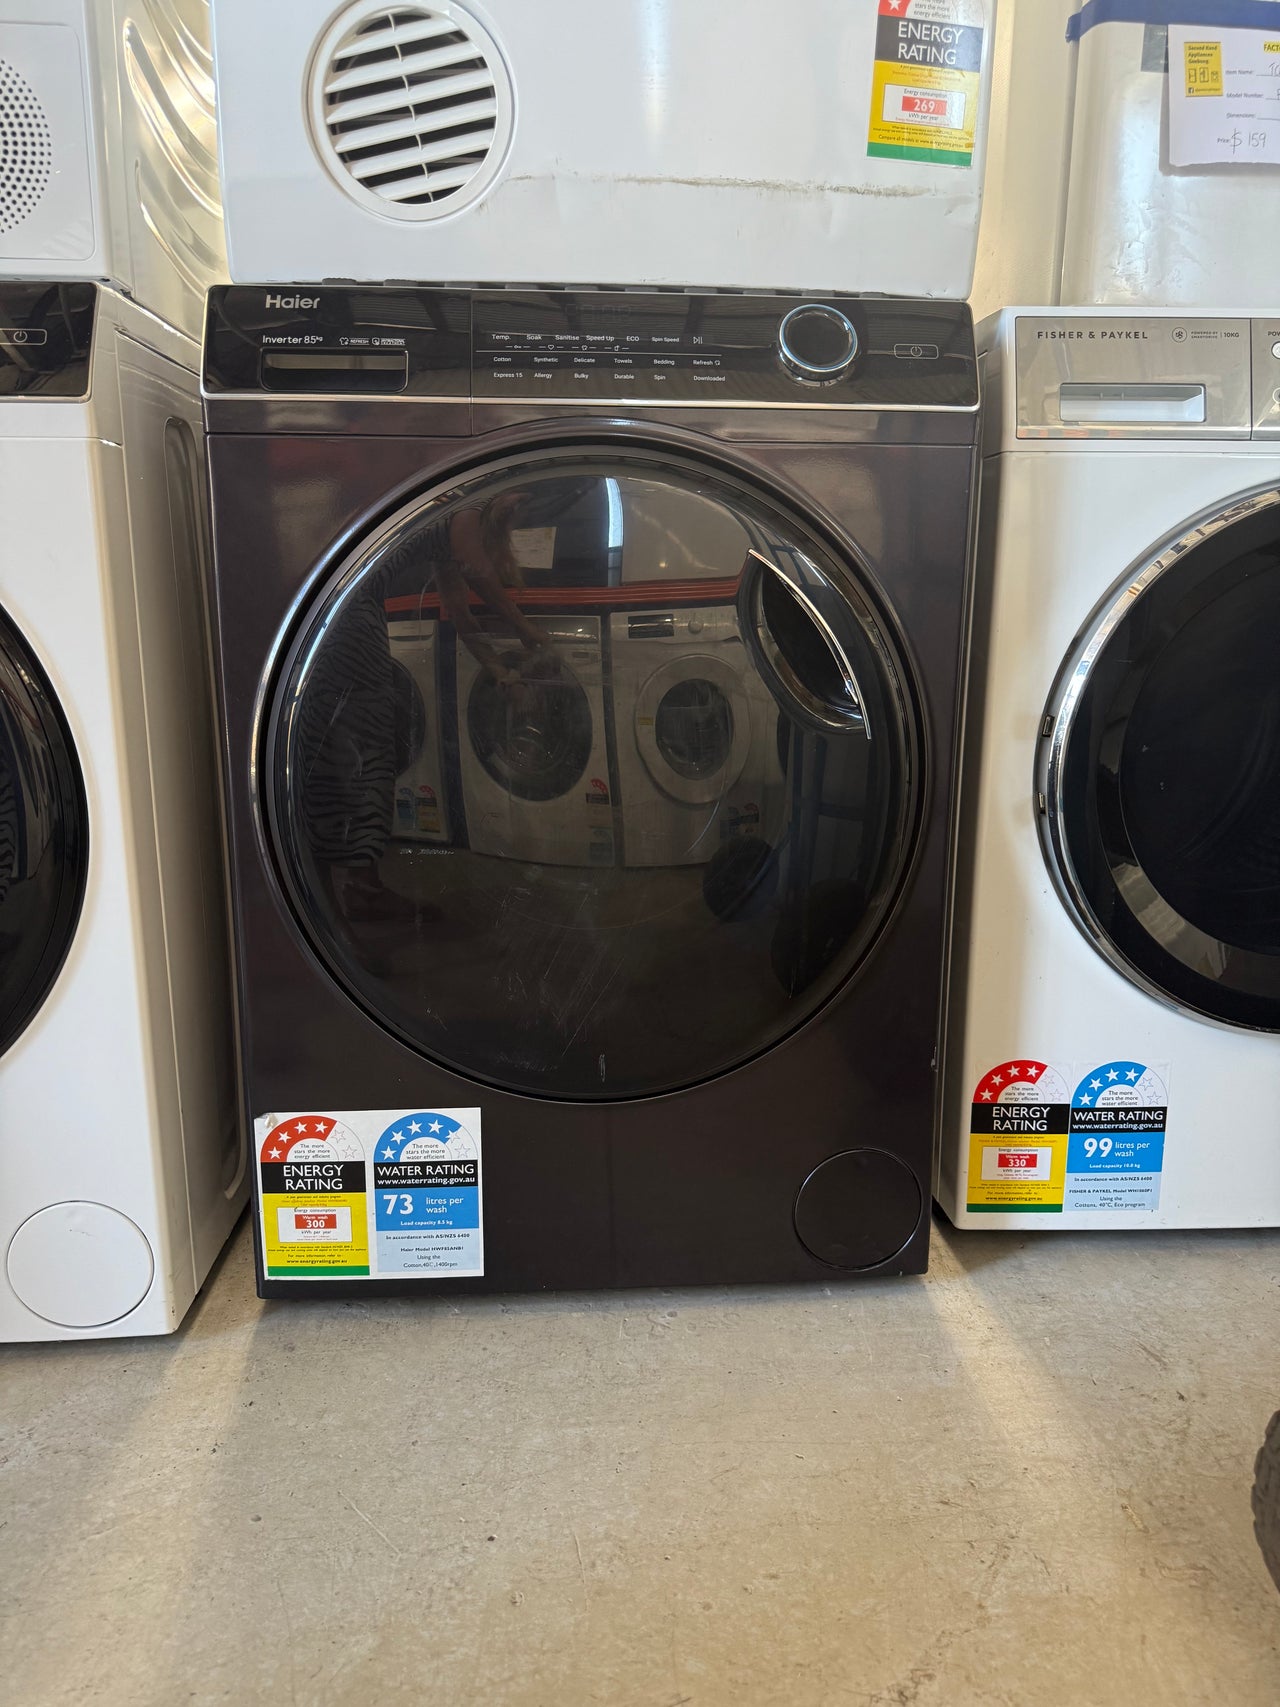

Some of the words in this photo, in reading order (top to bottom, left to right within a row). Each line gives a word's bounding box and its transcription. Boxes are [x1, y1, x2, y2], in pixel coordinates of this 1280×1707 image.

[898, 21, 964, 45] ENERGY
[898, 43, 957, 65] RATING
[904, 88, 919, 97] Energy
[914, 98, 936, 113] 269
[1231, 128, 1242, 155] $
[1248, 132, 1267, 148] 159
[265, 294, 321, 309] Haier
[262, 335, 302, 344] Inverter
[1037, 331, 1084, 339] FISHER
[1088, 331, 1096, 339] &
[1101, 331, 1148, 339] PAYKEL
[992, 1107, 1051, 1118] ENERGY
[1073, 1111, 1115, 1121] WATER
[1118, 1110, 1164, 1121] RATING
[993, 1120, 1048, 1131] RATING
[1072, 1122, 1163, 1131] www.waterrating.gov.au
[1083, 1137, 1113, 1158] 99
[1115, 1141, 1134, 1149] litres
[1136, 1142, 1150, 1150] per
[1008, 1159, 1027, 1167] 330
[283, 1164, 344, 1177] ENERGY
[377, 1165, 422, 1176] WATER
[426, 1164, 475, 1175] RATING
[285, 1178, 343, 1191] RATING
[377, 1176, 476, 1185] www.waterrating.gov.au
[383, 1194, 414, 1215] 73
[425, 1197, 447, 1205] litres
[449, 1197, 465, 1206] per
[425, 1206, 447, 1214] wash
[306, 1219, 325, 1228] 300
